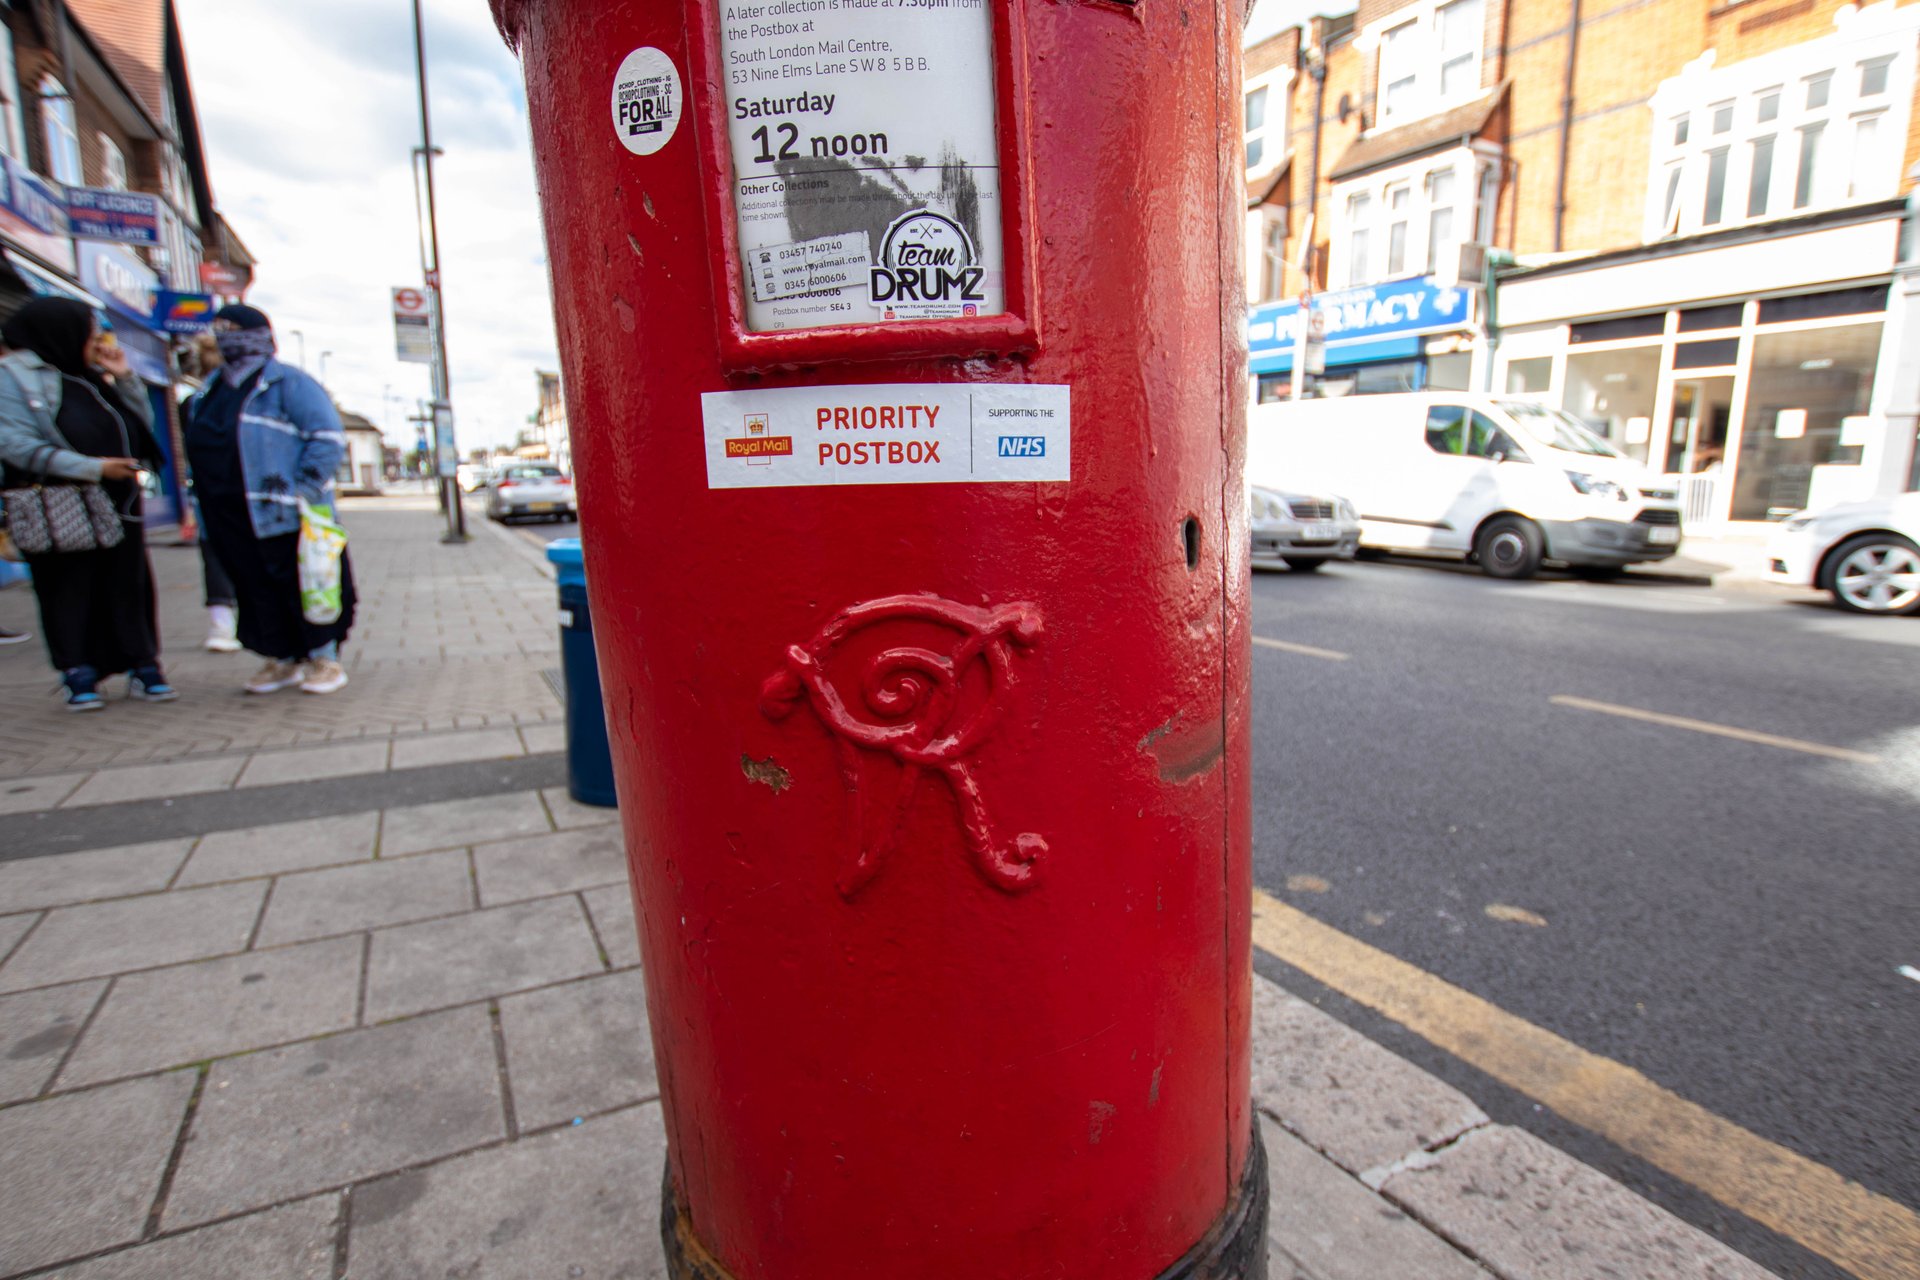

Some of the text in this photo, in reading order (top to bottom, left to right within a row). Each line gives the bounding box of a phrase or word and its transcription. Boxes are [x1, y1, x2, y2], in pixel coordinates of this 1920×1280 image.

[726, 7, 736, 21] A
[737, 6, 766, 20] later
[768, 0, 826, 16] collection
[829, 0, 839, 10] is
[842, 0, 878, 9] made
[728, 20, 815, 41] the Postbox at
[730, 38, 893, 64] South London Mail Centre,
[732, 70, 748, 84] 53
[751, 66, 779, 82] Nine
[782, 64, 812, 79] Elms
[815, 62, 846, 76] Lane
[618, 96, 672, 126] FOR ALL
[734, 90, 836, 120] Saturday
[751, 122, 888, 164] 12 noon
[740, 179, 830, 196] Other Collections
[741, 200, 778, 211] Additional
[979, 191, 994, 199] last
[742, 212, 788, 222] time shown.
[780, 240, 842, 260] 03457 740740
[898, 240, 957, 267] team
[782, 254, 866, 275] www.royalmail.com
[784, 273, 847, 290] 0345 6000606
[870, 268, 985, 302] DRUMZ
[772, 302, 852, 316] Postbox number SE4 3
[816, 405, 941, 431] PRIORITY
[988, 408, 1054, 418] SUPPORTING THE
[728, 438, 789, 456] Royal Mail
[818, 440, 942, 466] POSTBOX
[1000, 437, 1045, 456] NHS
